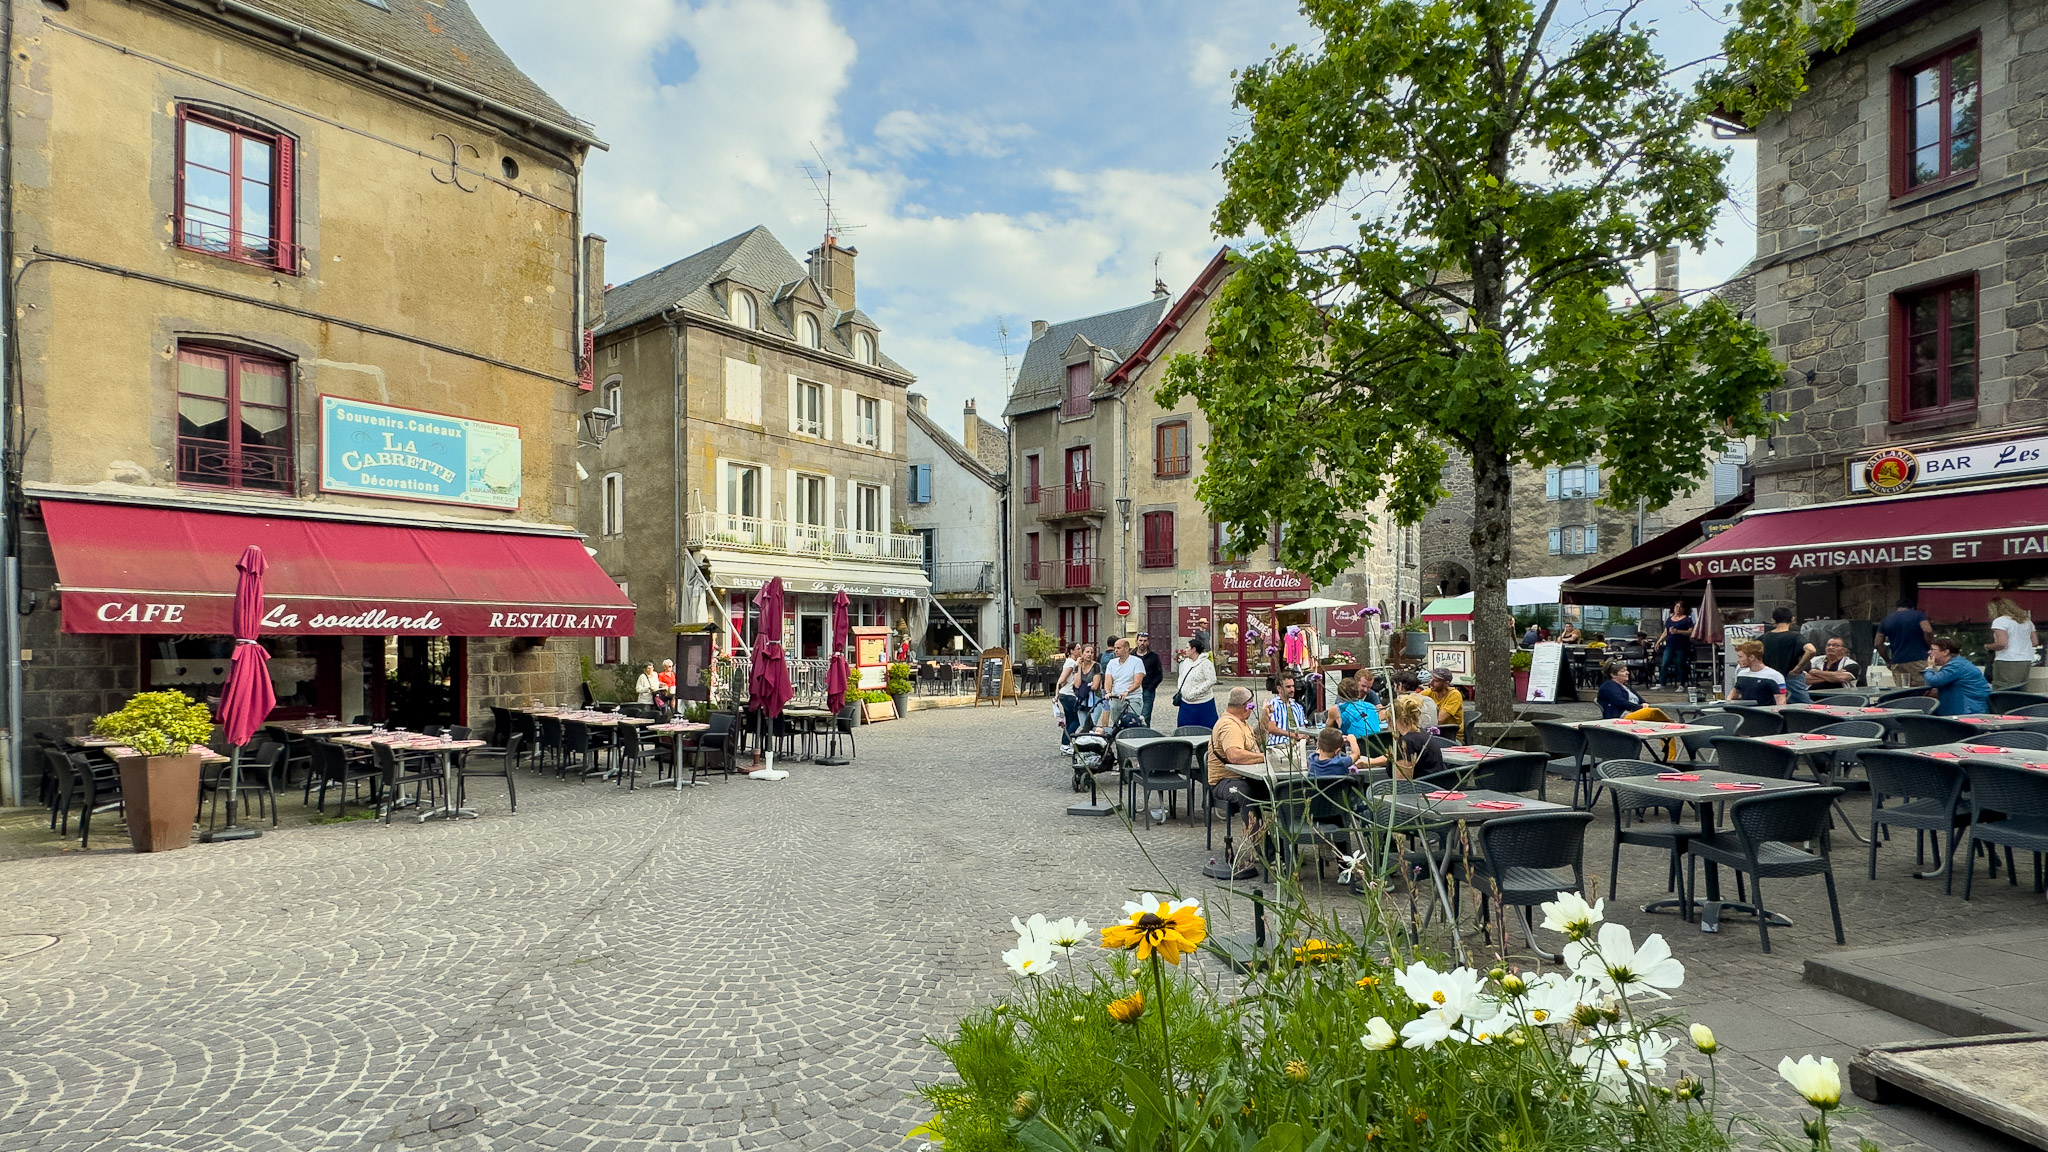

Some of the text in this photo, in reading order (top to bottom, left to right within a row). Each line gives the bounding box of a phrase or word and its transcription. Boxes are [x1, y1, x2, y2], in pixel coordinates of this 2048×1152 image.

[382, 432, 418, 454] LA
[341, 450, 456, 484] CABRETTE
[1865, 450, 1915, 470] PAULANER
[1926, 445, 2040, 473] BAR Les
[361, 473, 440, 493] Décorations
[1707, 555, 1776, 574] GLACES
[1788, 544, 1933, 569] ARTISANALES
[1952, 541, 1982, 560] ET
[733, 578, 793, 589] RESTANT
[881, 587, 916, 597] CREPERIE
[1223, 574, 1301, 589] Pluie d'étoiles
[97, 602, 617, 630] CAFE La souillarde RESTAURANT
[1246, 613, 1273, 637] SOLDES
[1436, 652, 1462, 665] GLACE
